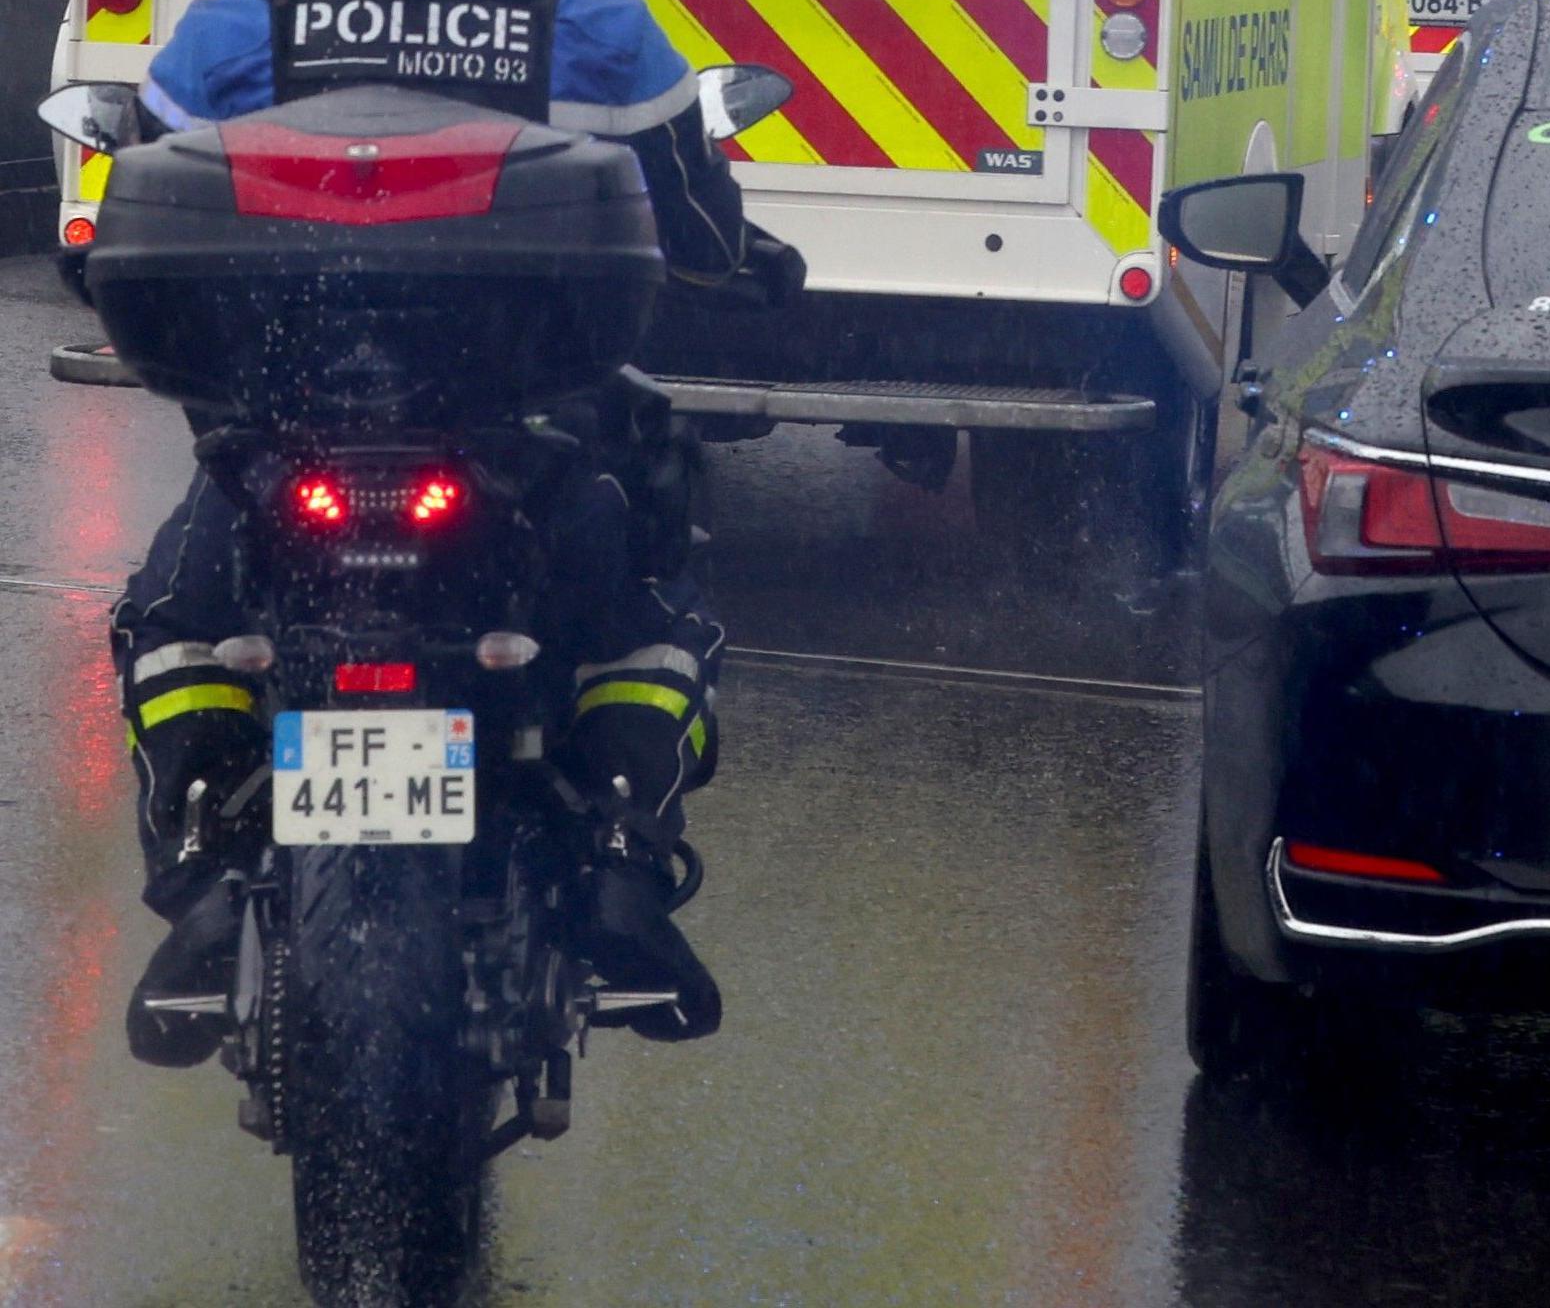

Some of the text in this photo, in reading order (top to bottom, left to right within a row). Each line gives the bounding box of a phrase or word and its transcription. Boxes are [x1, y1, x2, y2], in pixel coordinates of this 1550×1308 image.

[294, 0, 531, 53] POLICE
[397, 50, 527, 82] MOTO 93
[1181, 8, 1290, 101] SAMU DE PARIS
[984, 152, 1033, 169] WAS
[448, 745, 470, 765] 75
[291, 775, 464, 817] 441-ME
